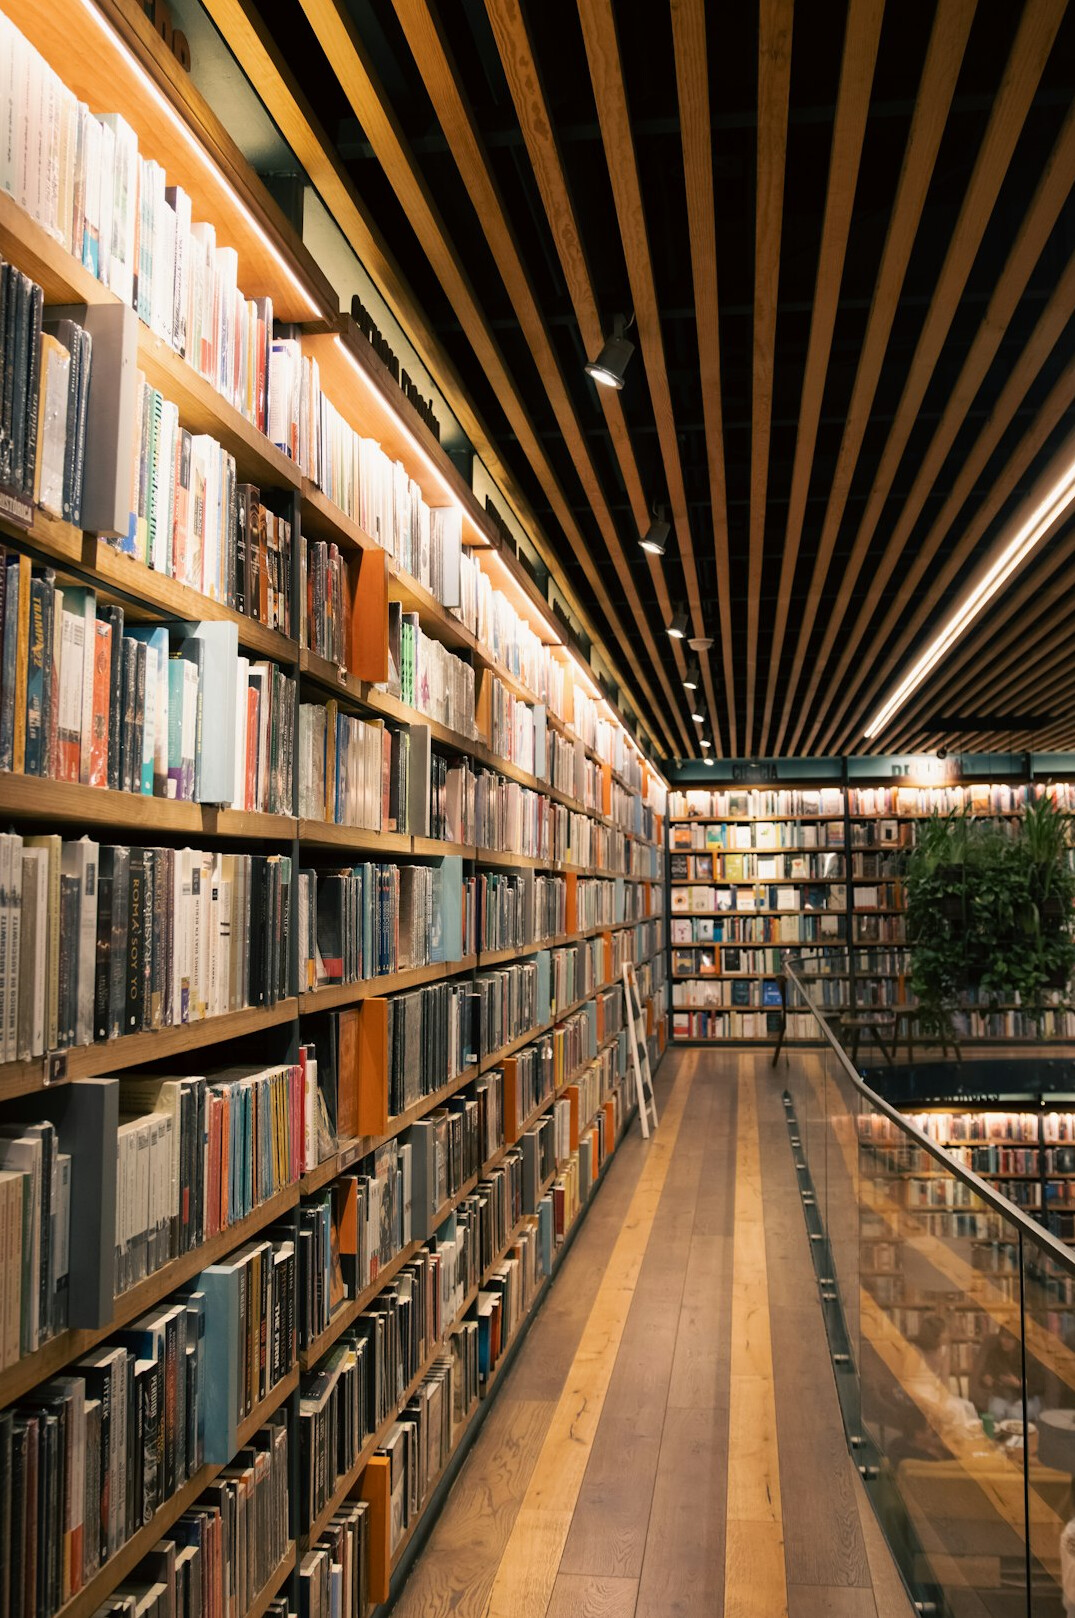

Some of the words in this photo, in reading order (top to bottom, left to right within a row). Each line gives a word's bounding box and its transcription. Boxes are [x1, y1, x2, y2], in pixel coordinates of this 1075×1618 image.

[29, 393, 38, 448] Traidora
[33, 597, 44, 651] TRAMPA
[33, 651, 43, 668] 22
[132, 878, 140, 931] ROMA
[144, 891, 152, 962] RASERO
[11, 915, 19, 974] AUSCHWITZ
[130, 976, 137, 1000] YO
[102, 1376, 110, 1421] FITZEK
[150, 1374, 158, 1418] PERDIDA
